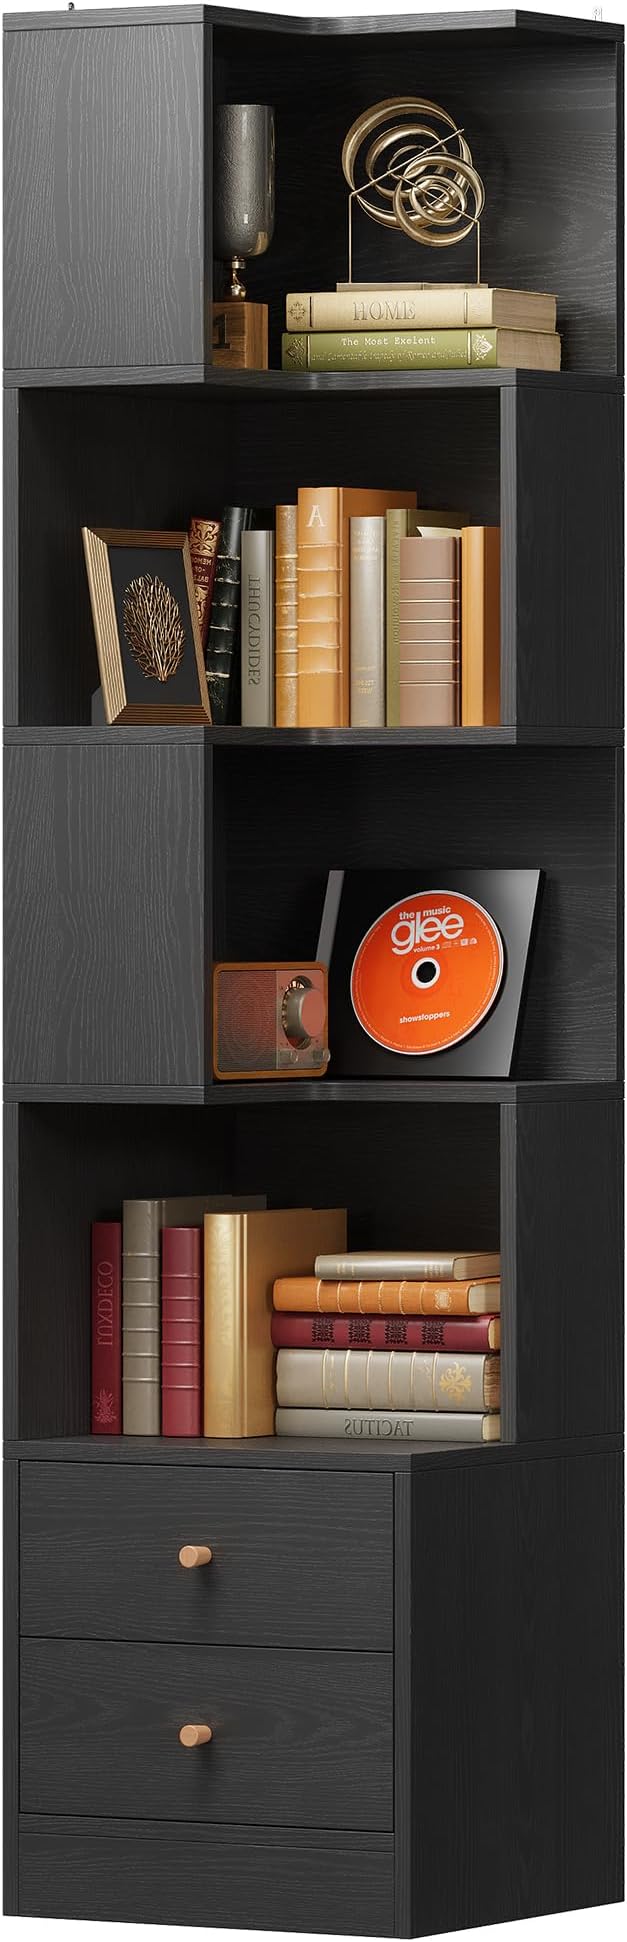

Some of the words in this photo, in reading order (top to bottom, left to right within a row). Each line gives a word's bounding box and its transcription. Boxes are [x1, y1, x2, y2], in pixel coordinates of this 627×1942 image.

[353, 301, 416, 321] HOME
[341, 338, 359, 347] The
[364, 337, 389, 346] Most
[306, 504, 327, 528] A
[399, 911, 416, 920] the
[423, 906, 453, 917] music
[391, 912, 465, 956] glee
[413, 946, 436, 954] volume
[399, 1011, 451, 1024] showstoppers
